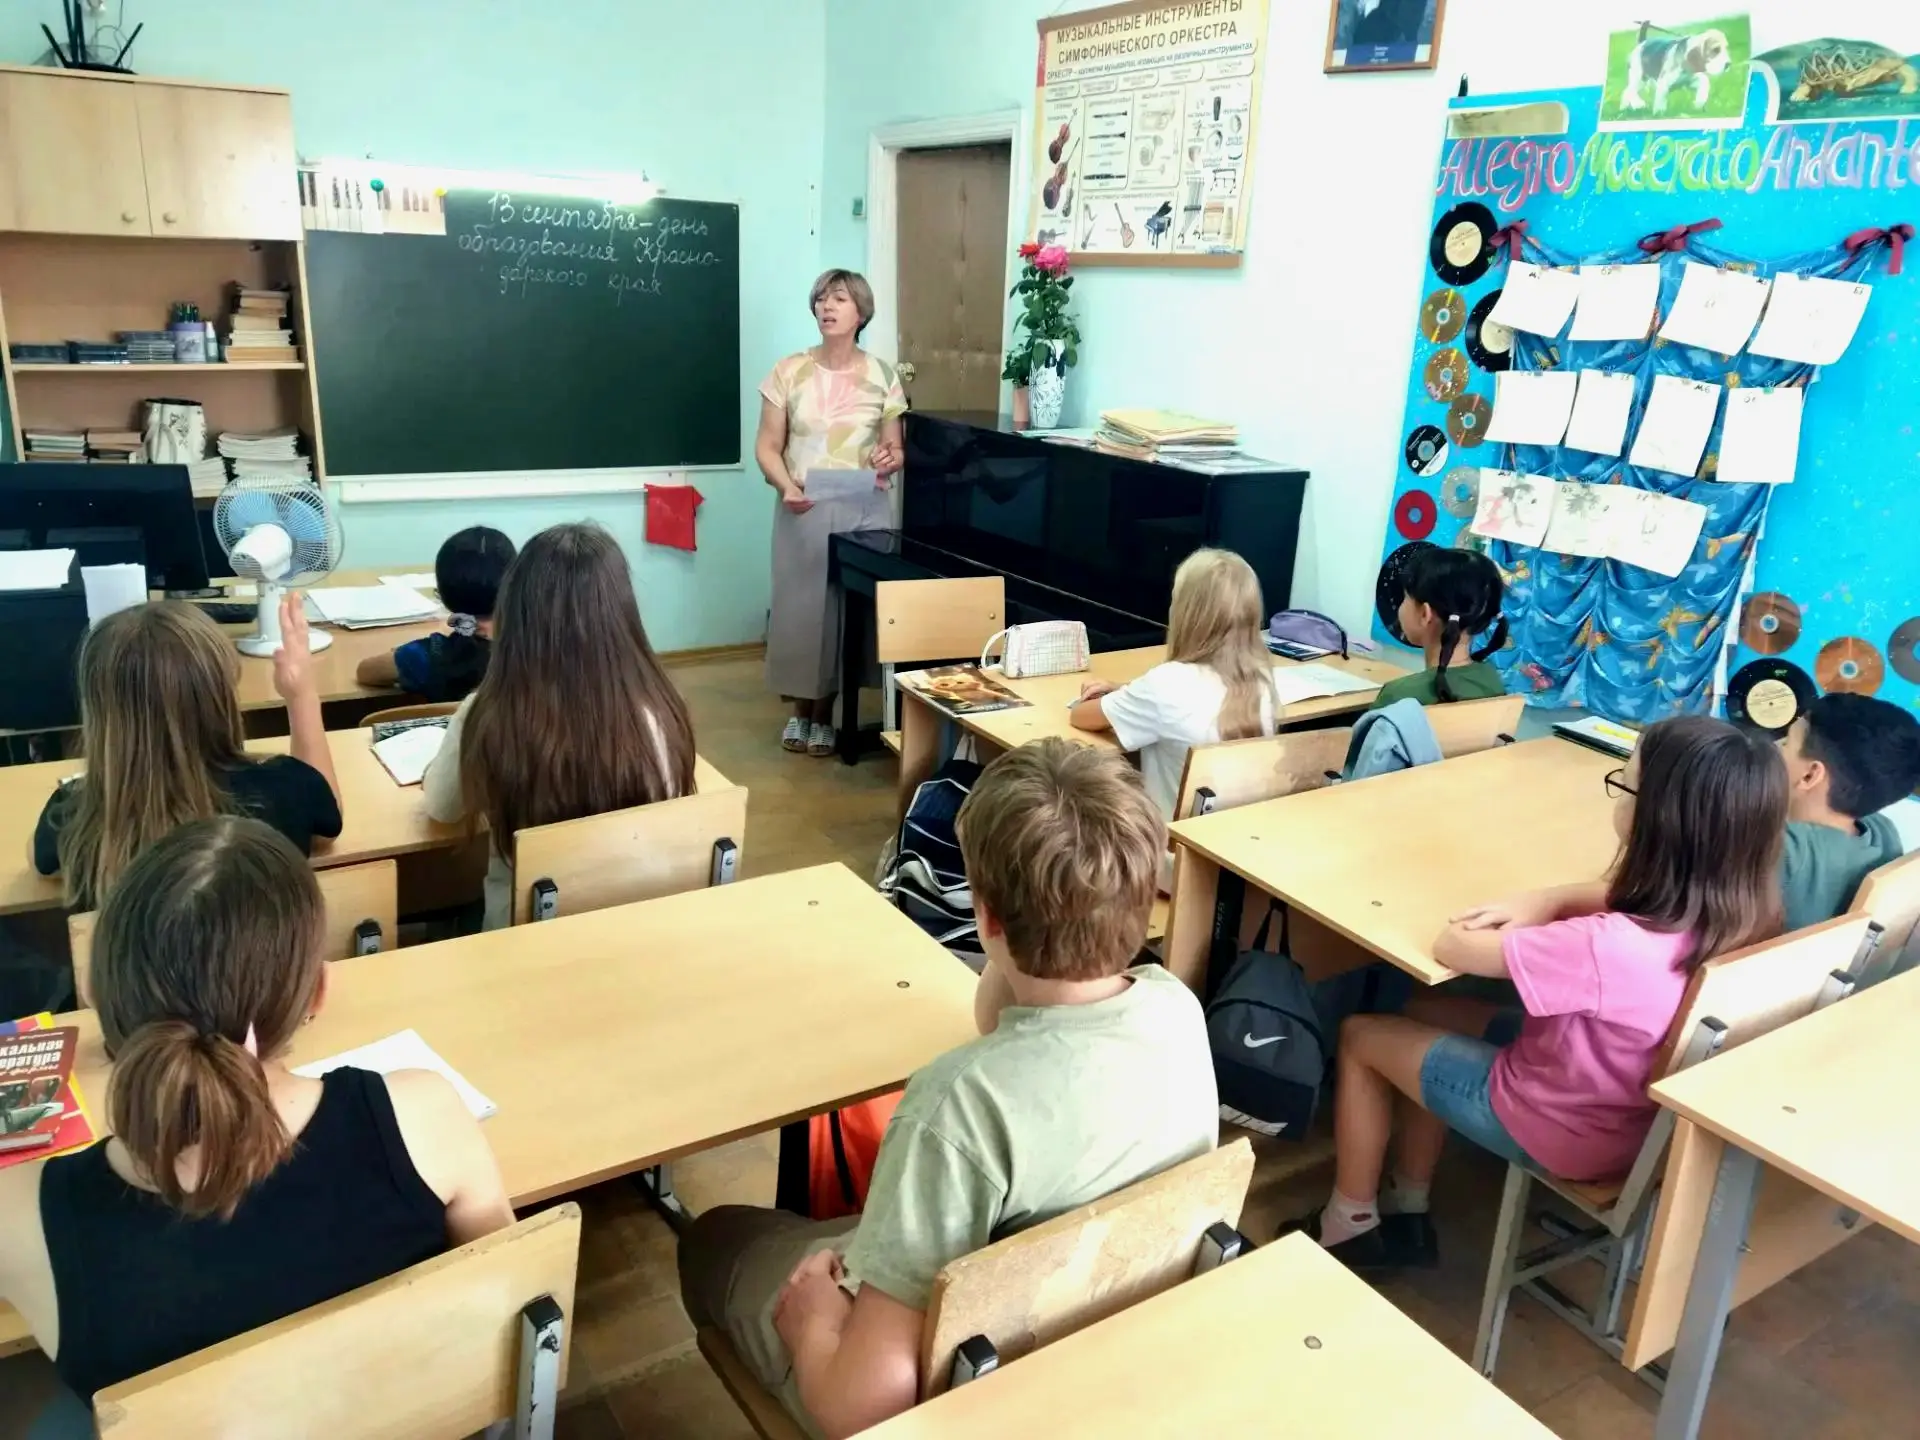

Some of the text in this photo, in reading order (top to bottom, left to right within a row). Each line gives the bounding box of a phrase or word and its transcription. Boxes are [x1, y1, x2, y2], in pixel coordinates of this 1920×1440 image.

[1057, 0, 1242, 44] МУЗЫКАЛЬНЫЕ ИНСТРУМЕНТЫ
[1058, 32, 1166, 65] СИМФОНИЧЕСКОГО
[1169, 21, 1237, 46] ОРКЕСТРА
[1436, 138, 1575, 212] Allegro
[1563, 129, 1760, 198] Moderato
[487, 191, 515, 223] 13
[657, 216, 709, 248] день
[607, 272, 664, 307] края
